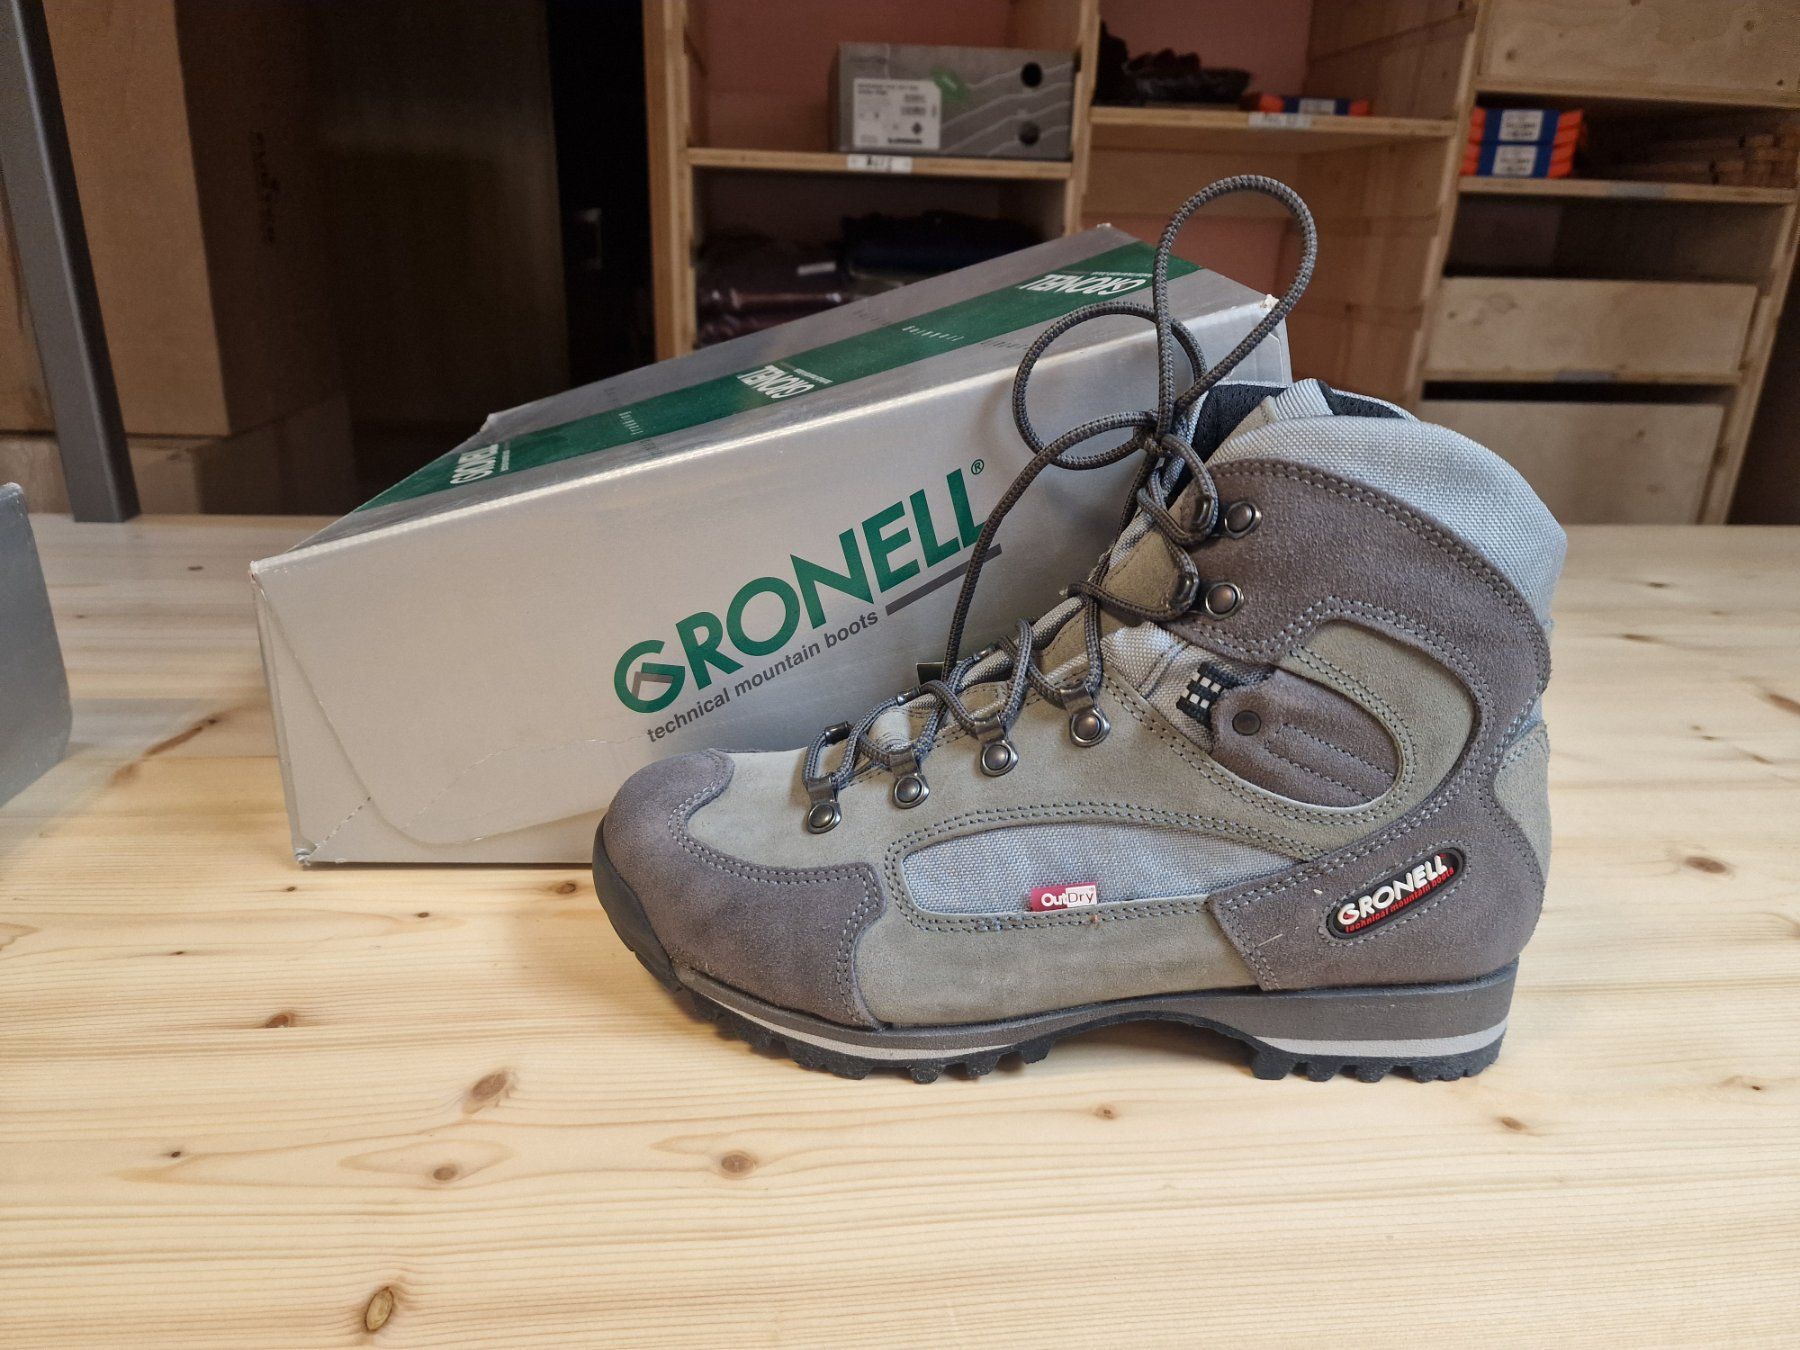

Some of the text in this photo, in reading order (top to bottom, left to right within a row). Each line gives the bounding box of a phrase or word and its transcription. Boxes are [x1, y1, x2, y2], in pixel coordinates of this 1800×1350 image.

[614, 468, 986, 714] GRONELL
[647, 611, 878, 743] technical mountain boots
[1041, 892, 1094, 907] OutDry
[1337, 855, 1448, 925] GRONELL
[1391, 884, 1431, 913] mountain
[1432, 866, 1454, 888] boots
